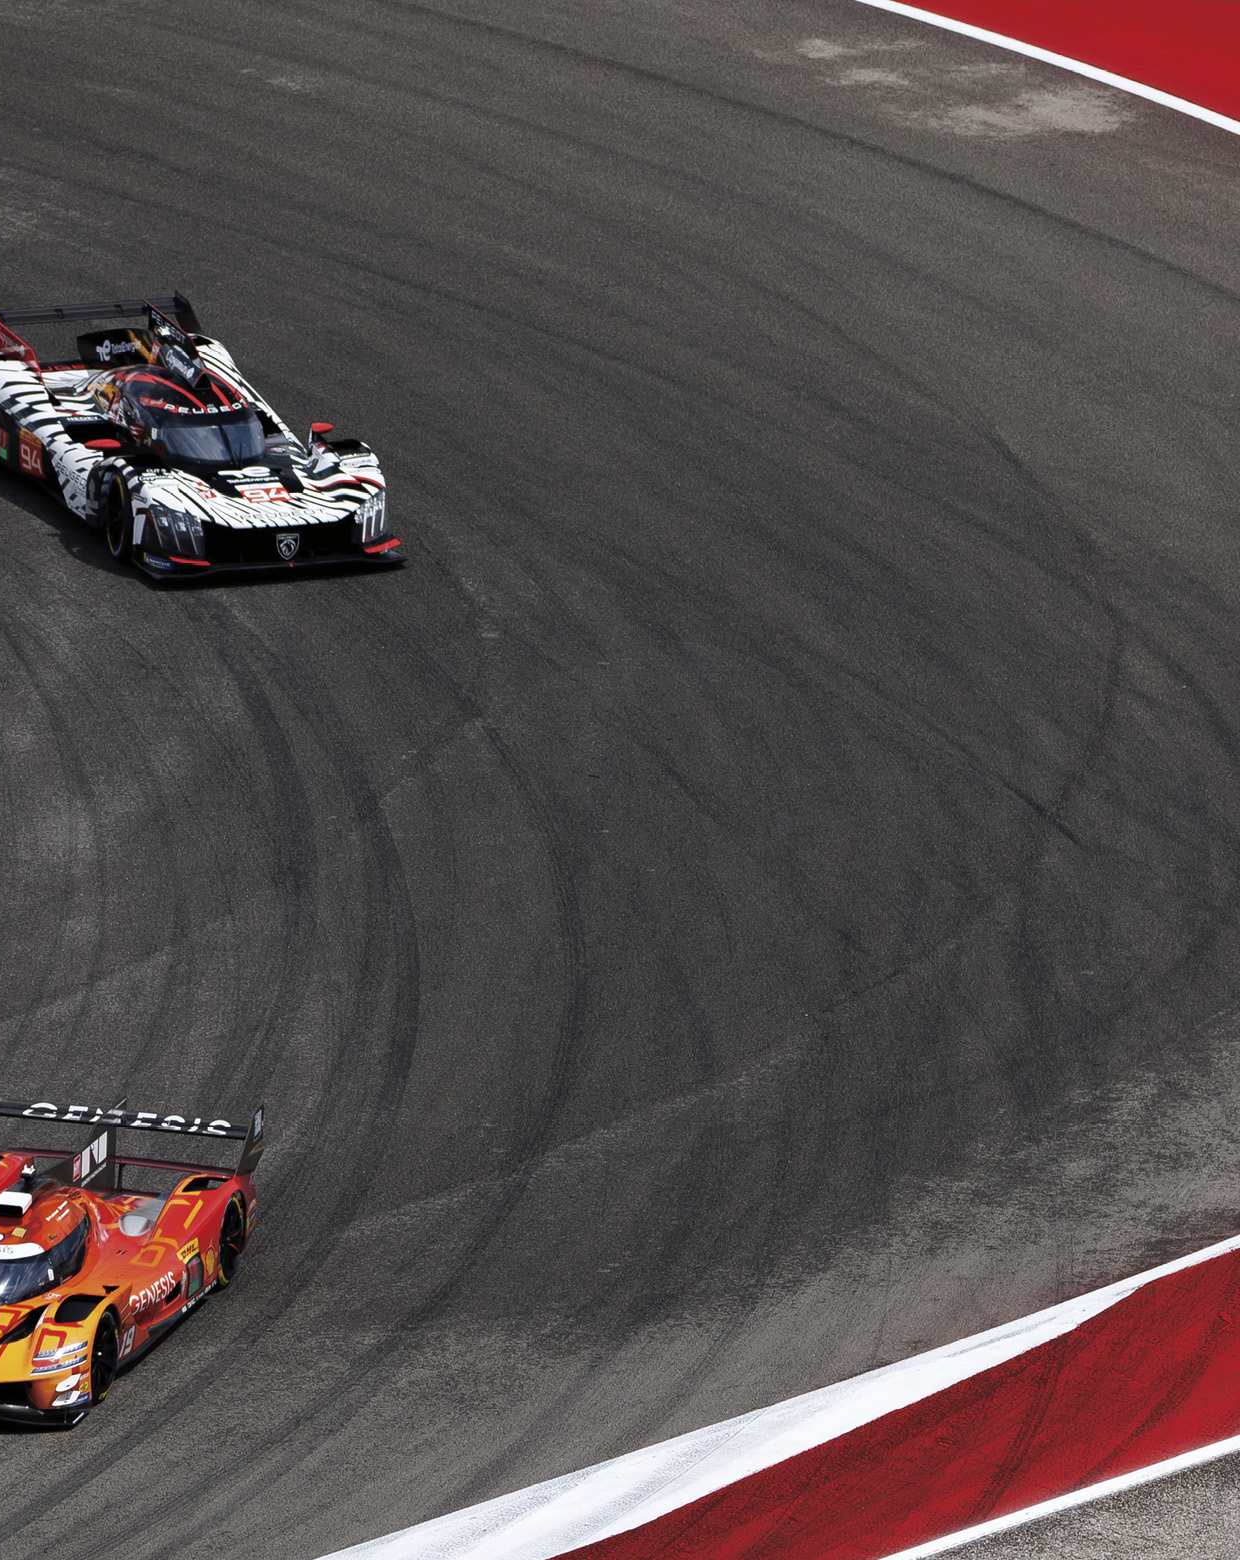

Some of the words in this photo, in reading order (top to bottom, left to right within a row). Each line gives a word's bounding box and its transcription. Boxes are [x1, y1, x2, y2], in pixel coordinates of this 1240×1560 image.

[164, 398, 246, 414] PEUGEOT
[21, 443, 42, 475] 94
[56, 461, 87, 489] PEUGEO
[243, 488, 291, 502] 94
[181, 1244, 195, 1259] DHL
[129, 1271, 176, 1315] GENESIS
[119, 1325, 135, 1358] 19
